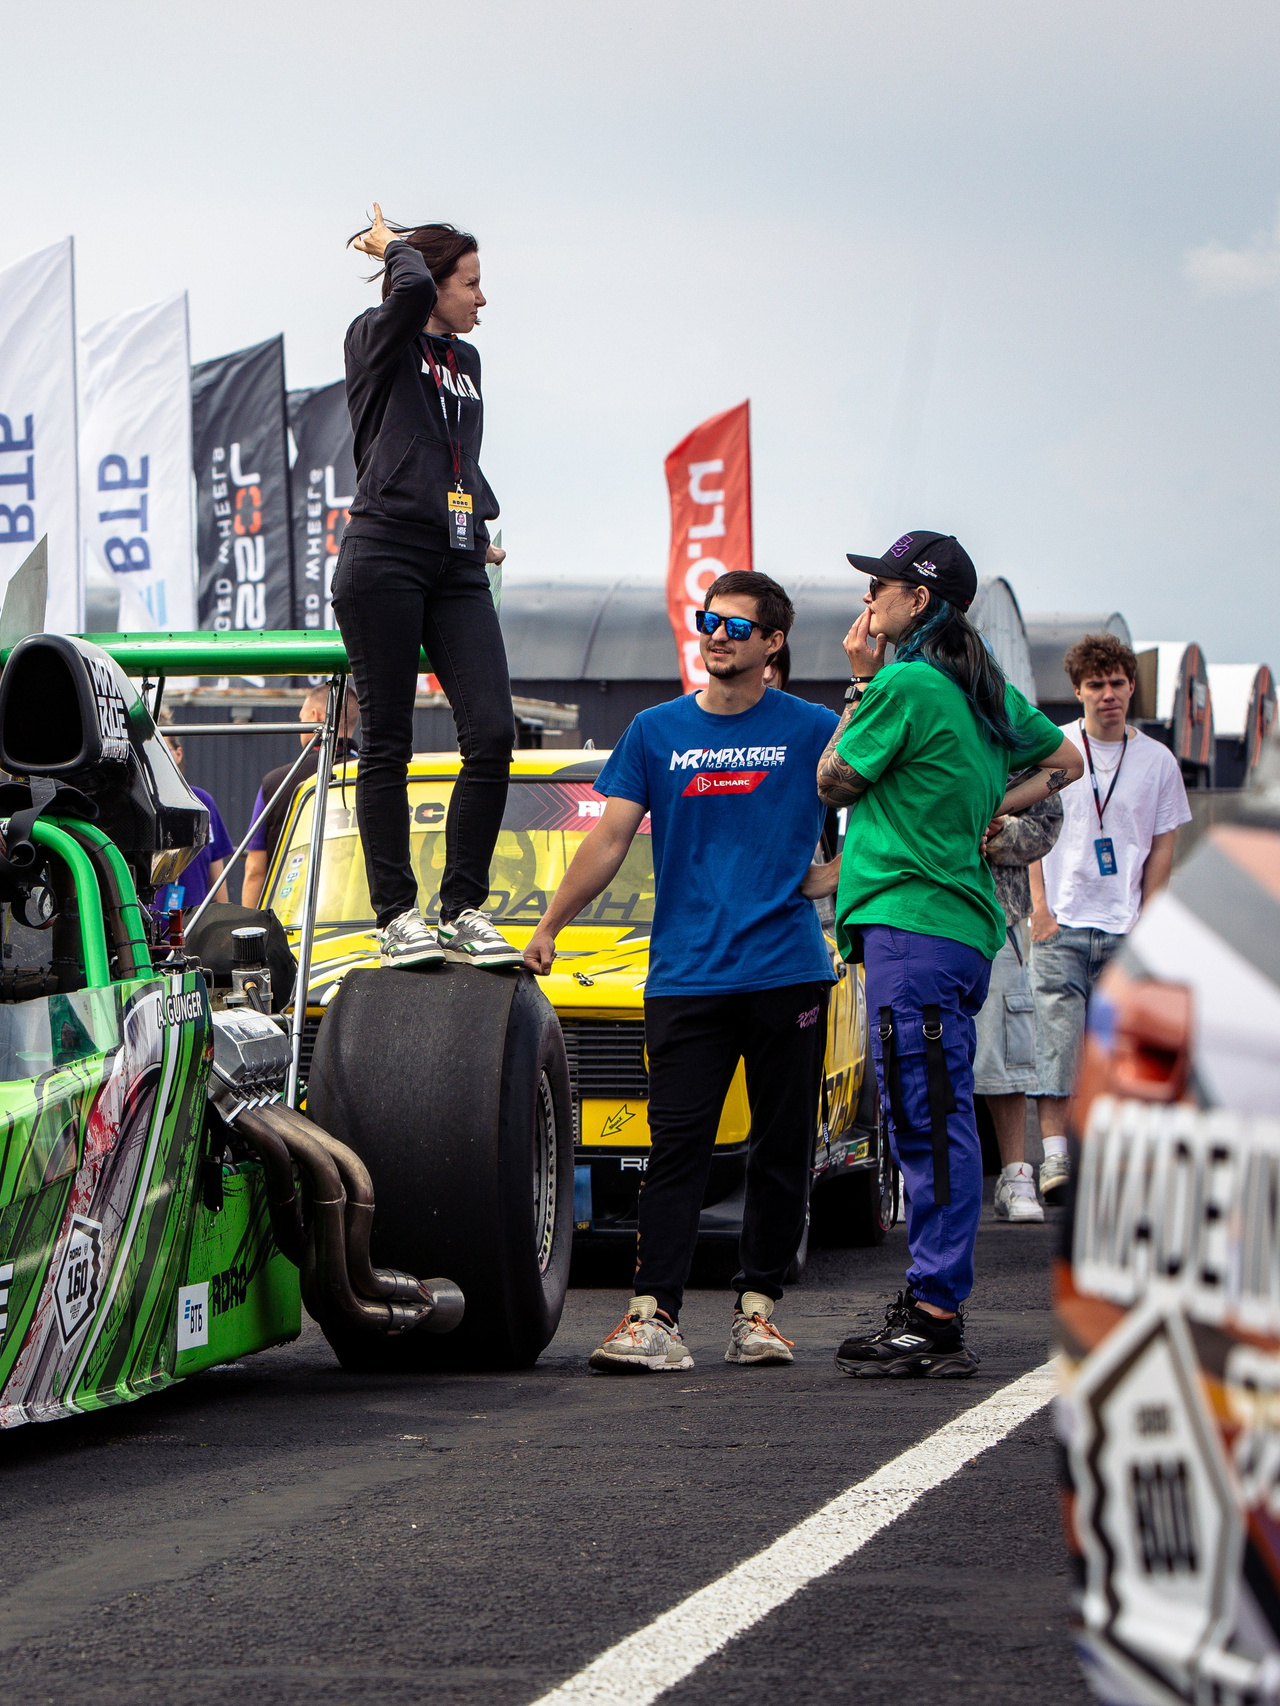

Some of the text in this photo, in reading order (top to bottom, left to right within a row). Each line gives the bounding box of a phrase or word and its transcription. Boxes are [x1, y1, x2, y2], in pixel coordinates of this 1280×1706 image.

[713, 779, 751, 788] LEMARC
[166, 990, 204, 1026] GUNGER
[65, 1258, 89, 1305] 160
[190, 1303, 202, 1334] ВТБ
